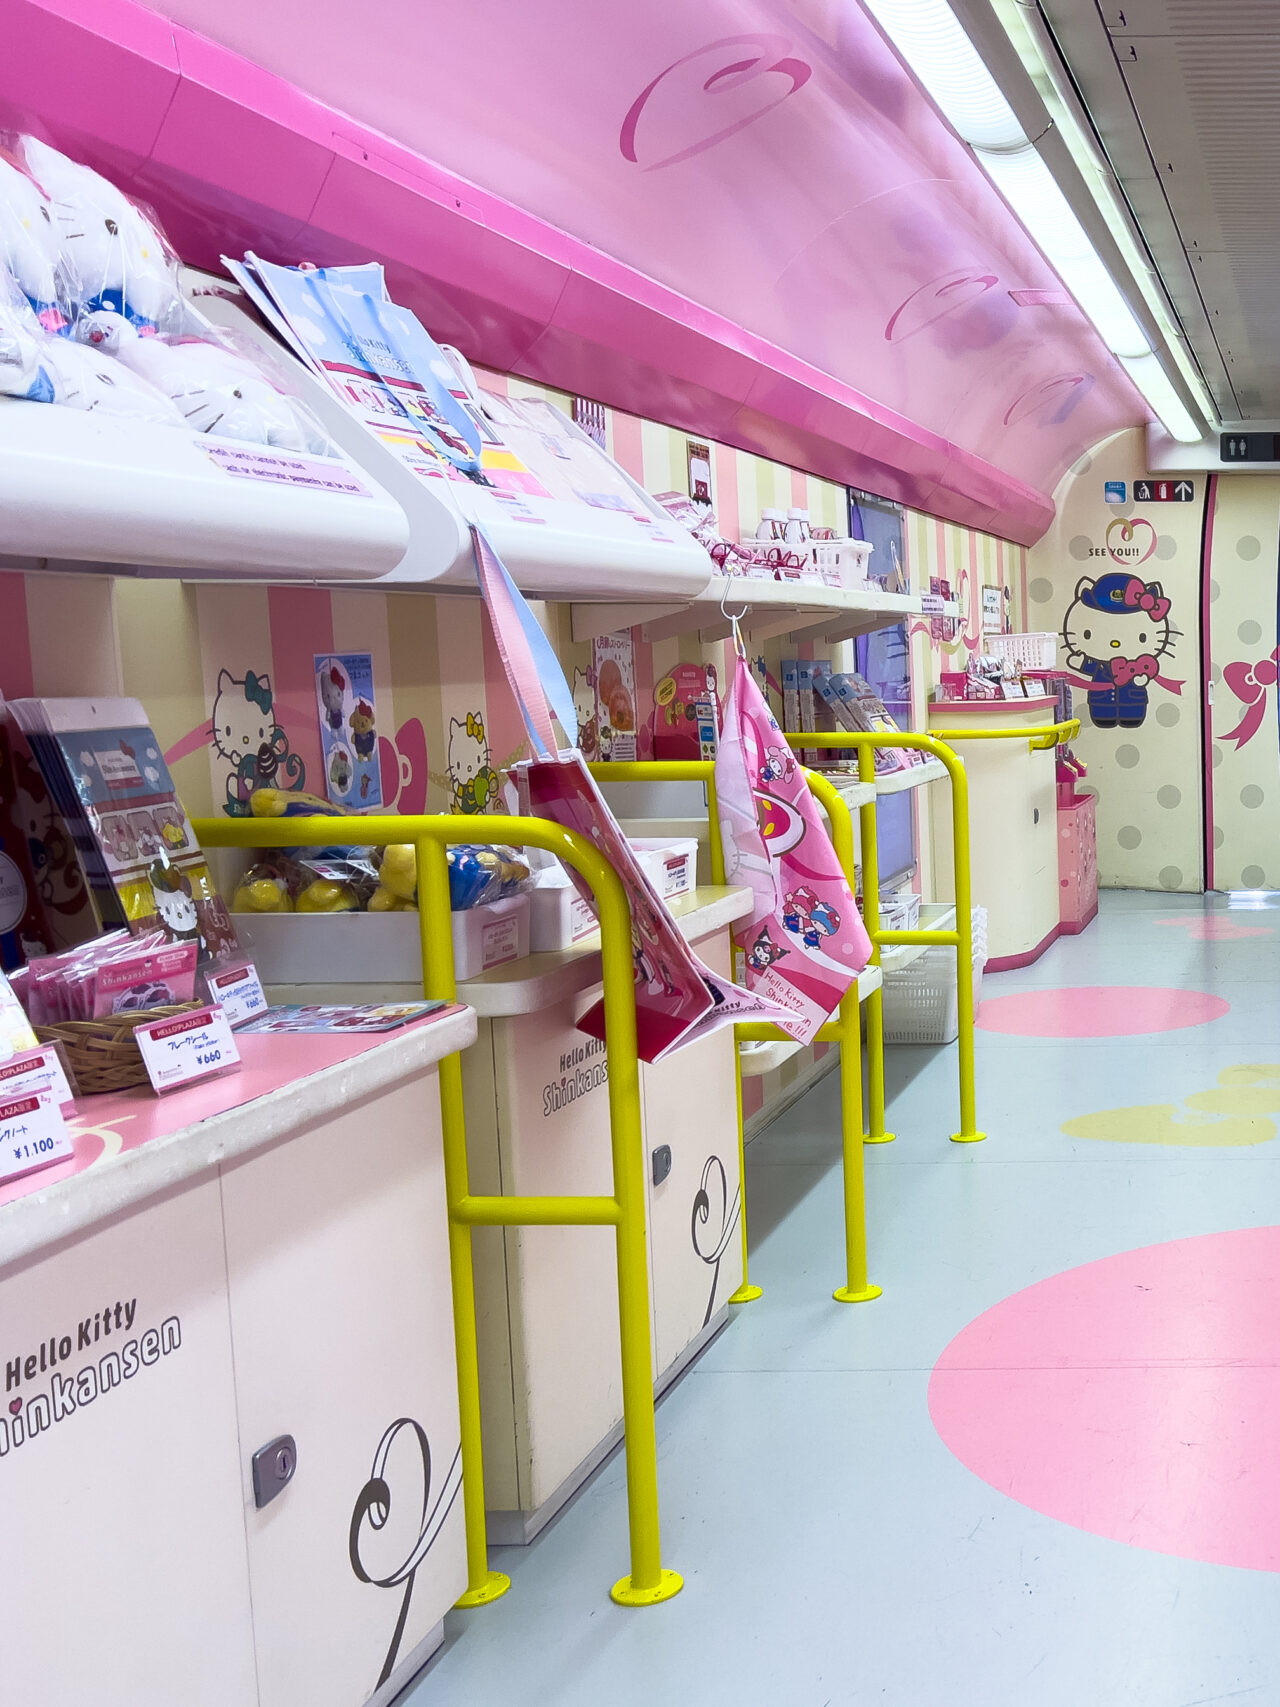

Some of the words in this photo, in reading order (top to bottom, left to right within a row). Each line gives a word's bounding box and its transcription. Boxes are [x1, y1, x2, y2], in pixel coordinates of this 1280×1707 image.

[1088, 548, 1107, 557] SEE
[1110, 548, 1140, 557] YOU!!
[764, 971, 784, 993] Hello
[784, 988, 805, 1009] Kitty
[196, 1049, 221, 1065] ¥660
[560, 1047, 584, 1073] Hello
[542, 1060, 609, 1117] Shinkans
[6, 1334, 72, 1392] Hello
[77, 1298, 137, 1351] Kitty
